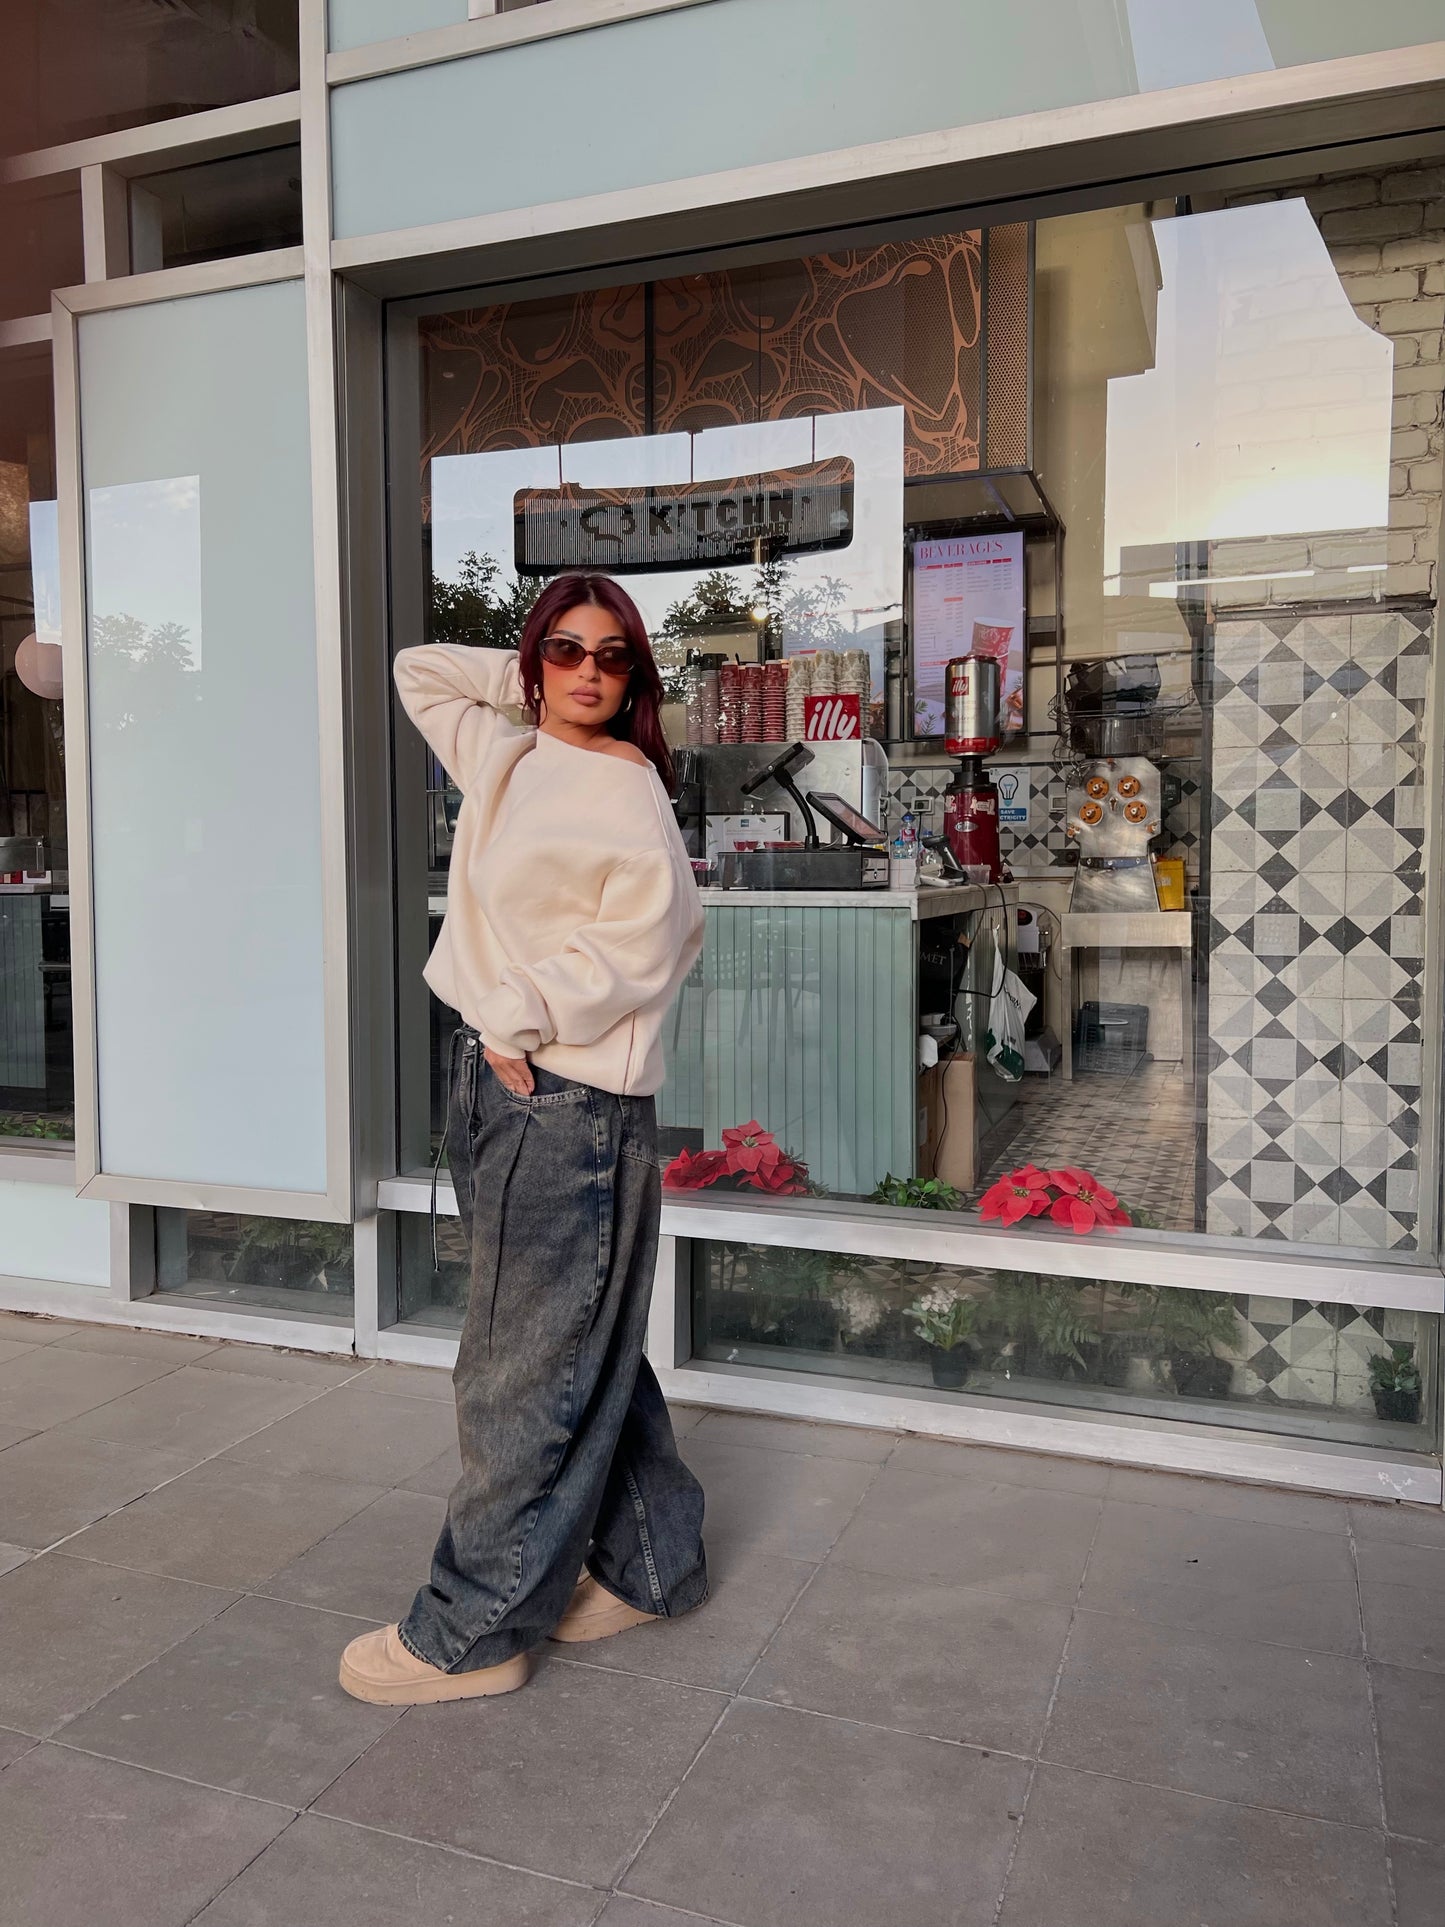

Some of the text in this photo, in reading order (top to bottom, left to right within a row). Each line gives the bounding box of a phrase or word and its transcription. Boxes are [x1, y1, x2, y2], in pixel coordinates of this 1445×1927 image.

[919, 540, 1003, 559] BEVERAGES
[952, 679, 968, 695] illy
[807, 699, 857, 740] illy
